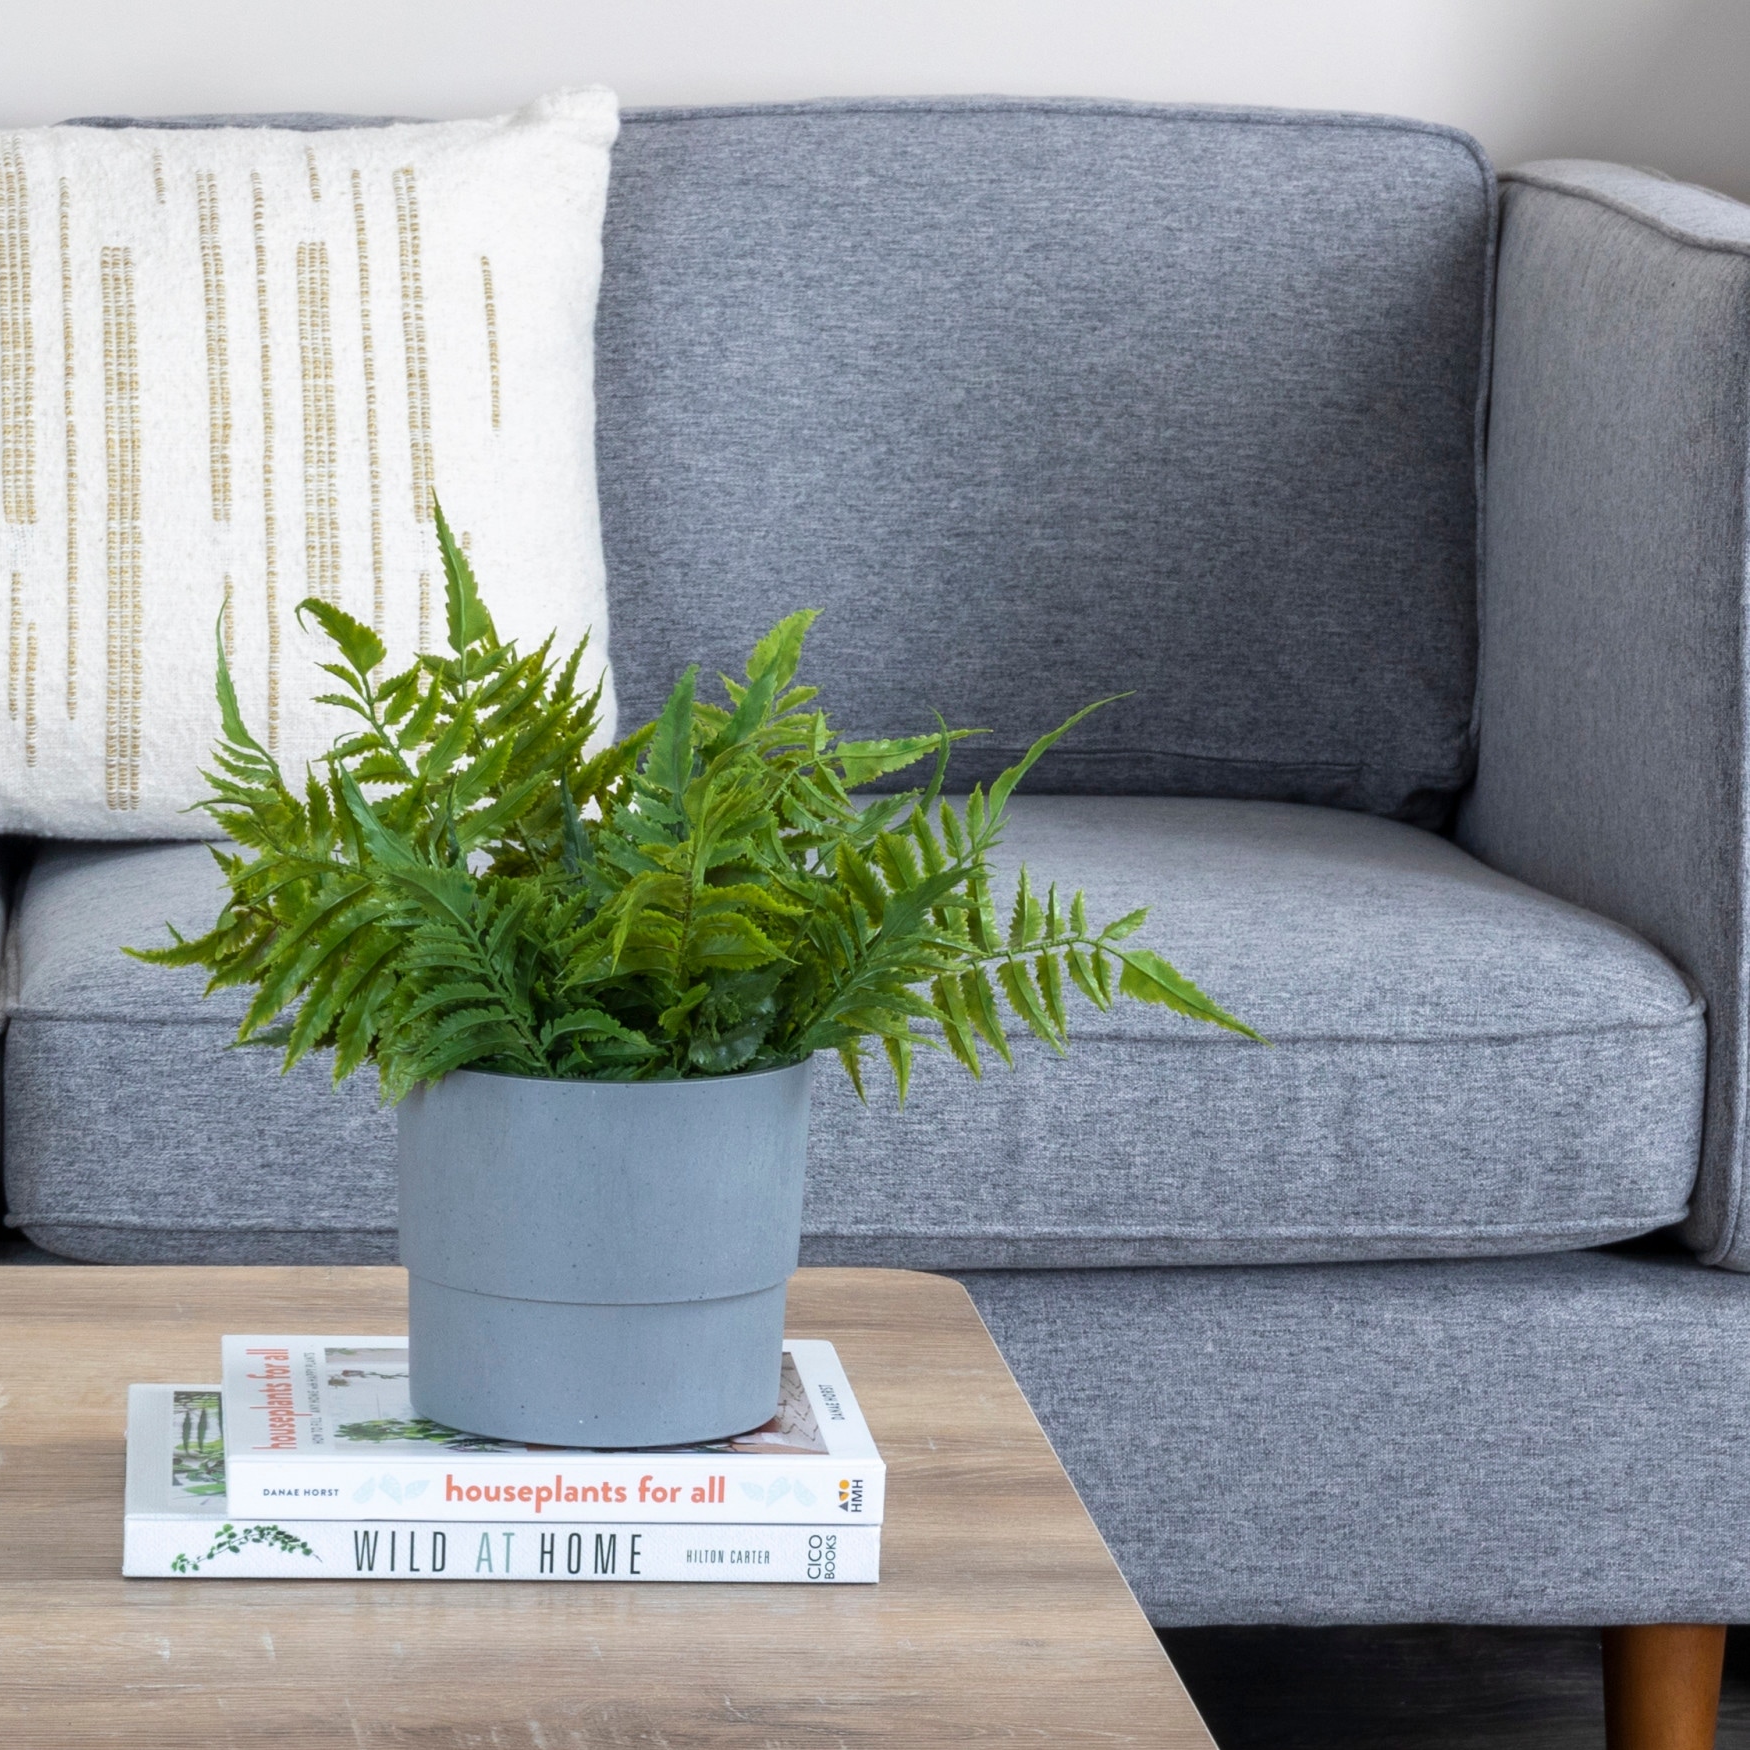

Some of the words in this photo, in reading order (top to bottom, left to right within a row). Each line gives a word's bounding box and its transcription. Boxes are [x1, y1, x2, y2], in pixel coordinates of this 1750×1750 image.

[246, 1348, 290, 1360] all
[246, 1363, 291, 1379] for
[250, 1383, 313, 1450] houseplants
[263, 1488, 300, 1497] DANAE
[303, 1488, 339, 1497] HORST
[445, 1474, 627, 1513] houseplants
[638, 1475, 682, 1503] for
[691, 1476, 725, 1503] all
[851, 1479, 863, 1512] HMH
[354, 1530, 446, 1572] WILD
[475, 1532, 515, 1573] AT
[540, 1533, 642, 1574] HOME
[686, 1549, 724, 1564] HILTON
[730, 1550, 770, 1564] CARTER
[807, 1534, 822, 1580] CICO
[824, 1534, 837, 1580] BOOKS
